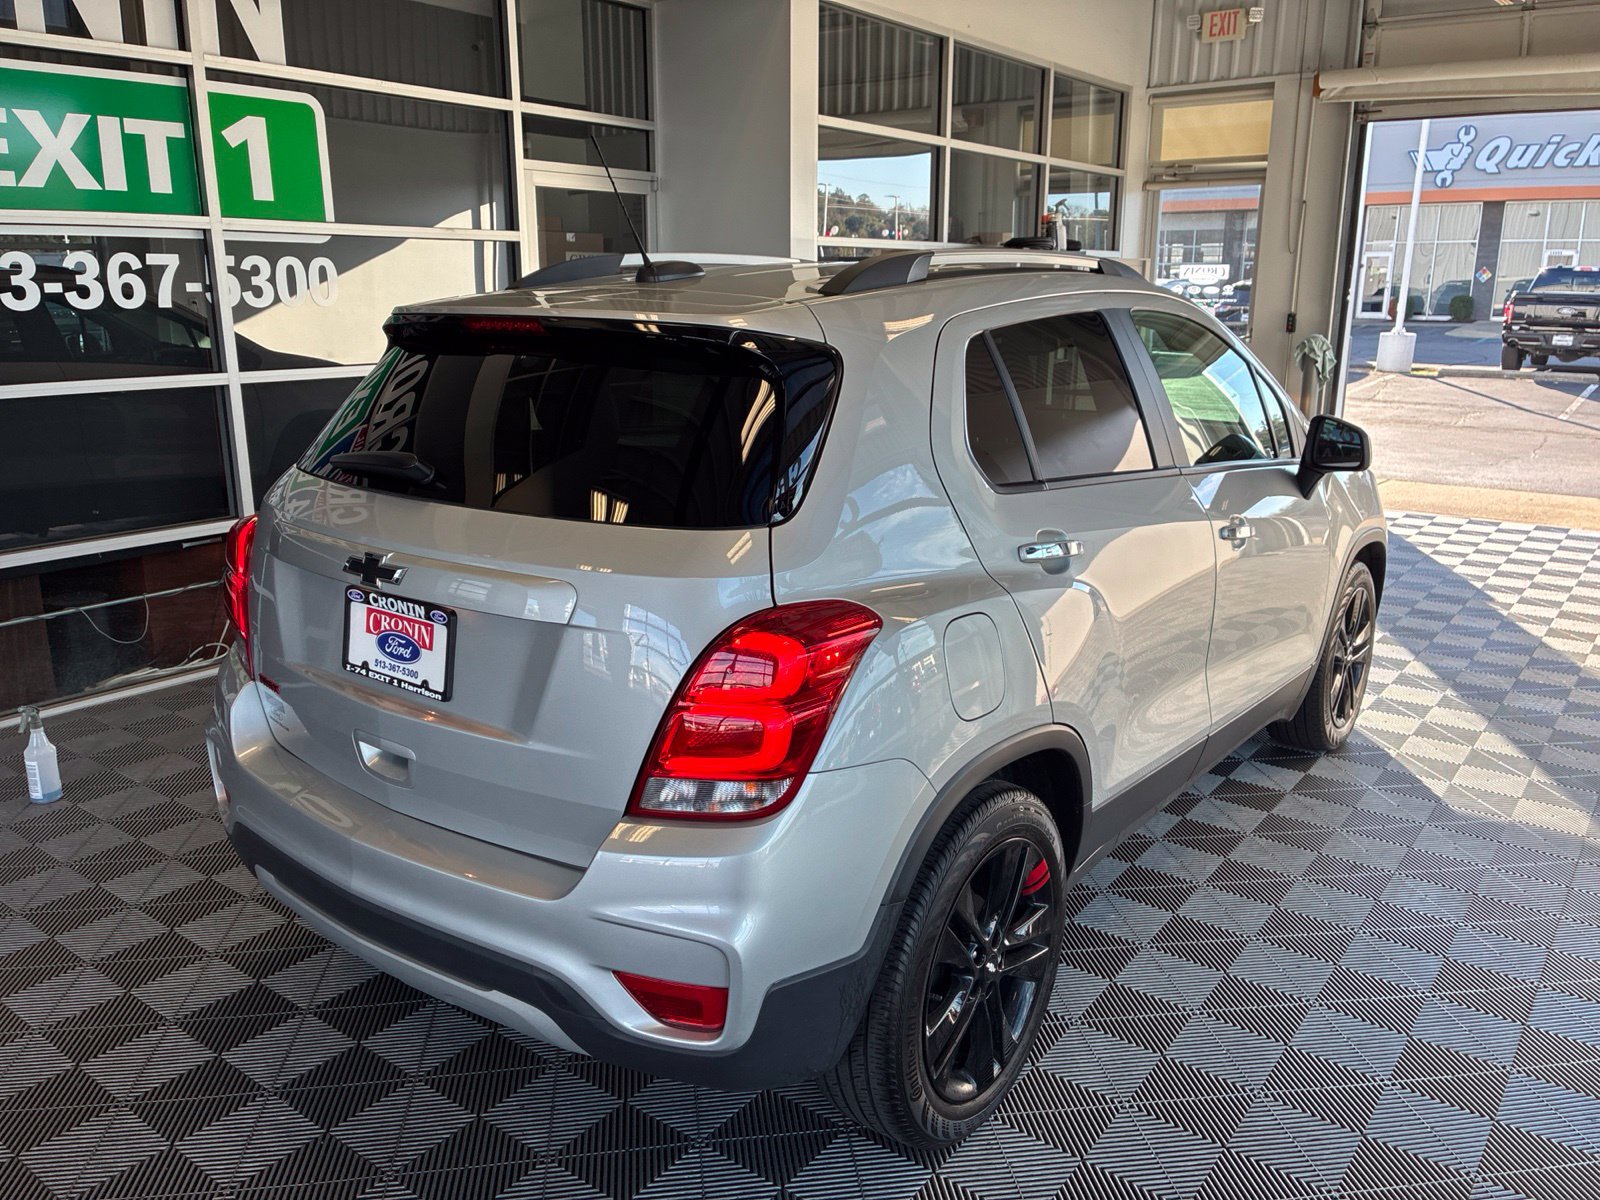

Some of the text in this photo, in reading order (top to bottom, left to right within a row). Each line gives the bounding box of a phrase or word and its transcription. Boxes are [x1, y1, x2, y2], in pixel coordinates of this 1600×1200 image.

[1209, 11, 1240, 37] EXIT
[220, 116, 275, 202] 1
[369, 593, 425, 619] CRONIN
[369, 612, 431, 649] CRONIN
[384, 635, 413, 660] Ford
[346, 664, 442, 700] I-74 EXIT 1 Harrison
[374, 658, 419, 680] 513-367-5300
